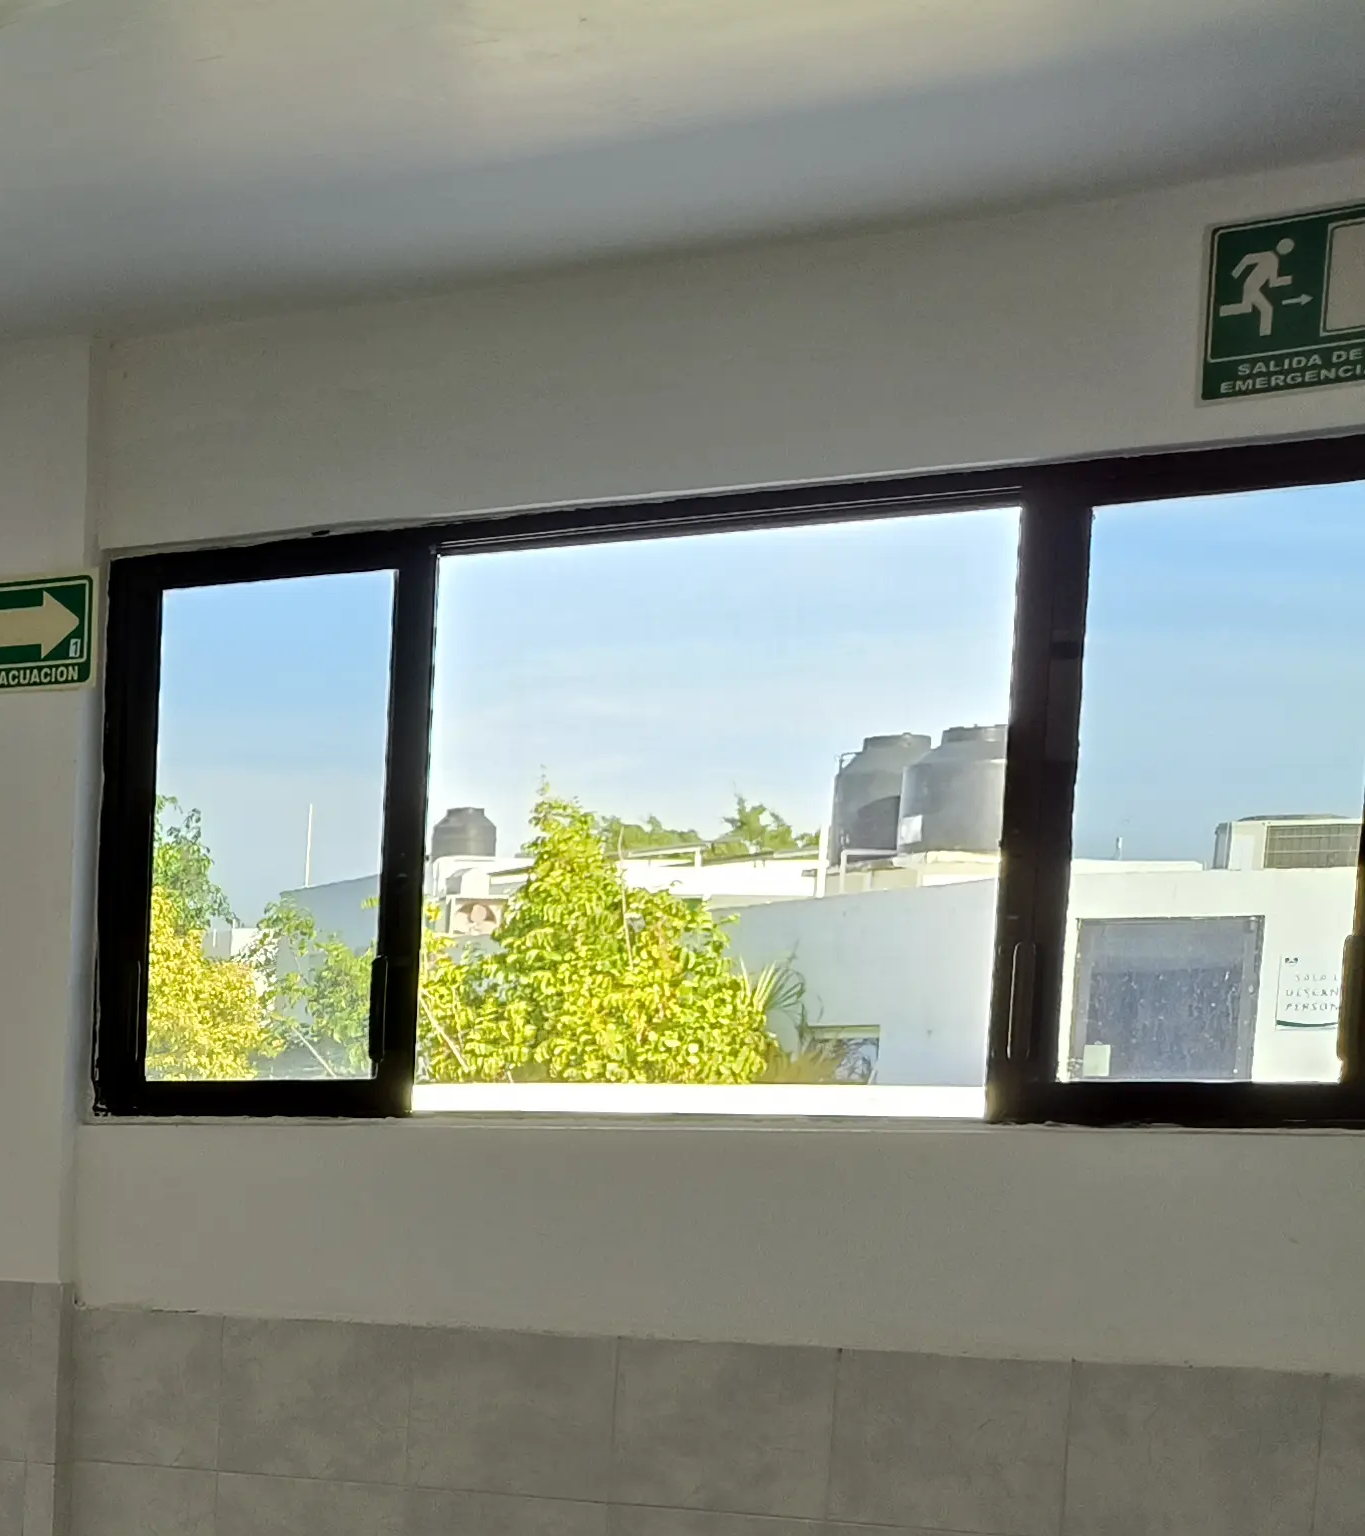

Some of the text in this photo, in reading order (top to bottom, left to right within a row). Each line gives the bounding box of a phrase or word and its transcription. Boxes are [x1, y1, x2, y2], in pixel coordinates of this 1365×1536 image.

[1237, 348, 1364, 376] SALIDA DE
[1220, 364, 1365, 394] EMERGENCI
